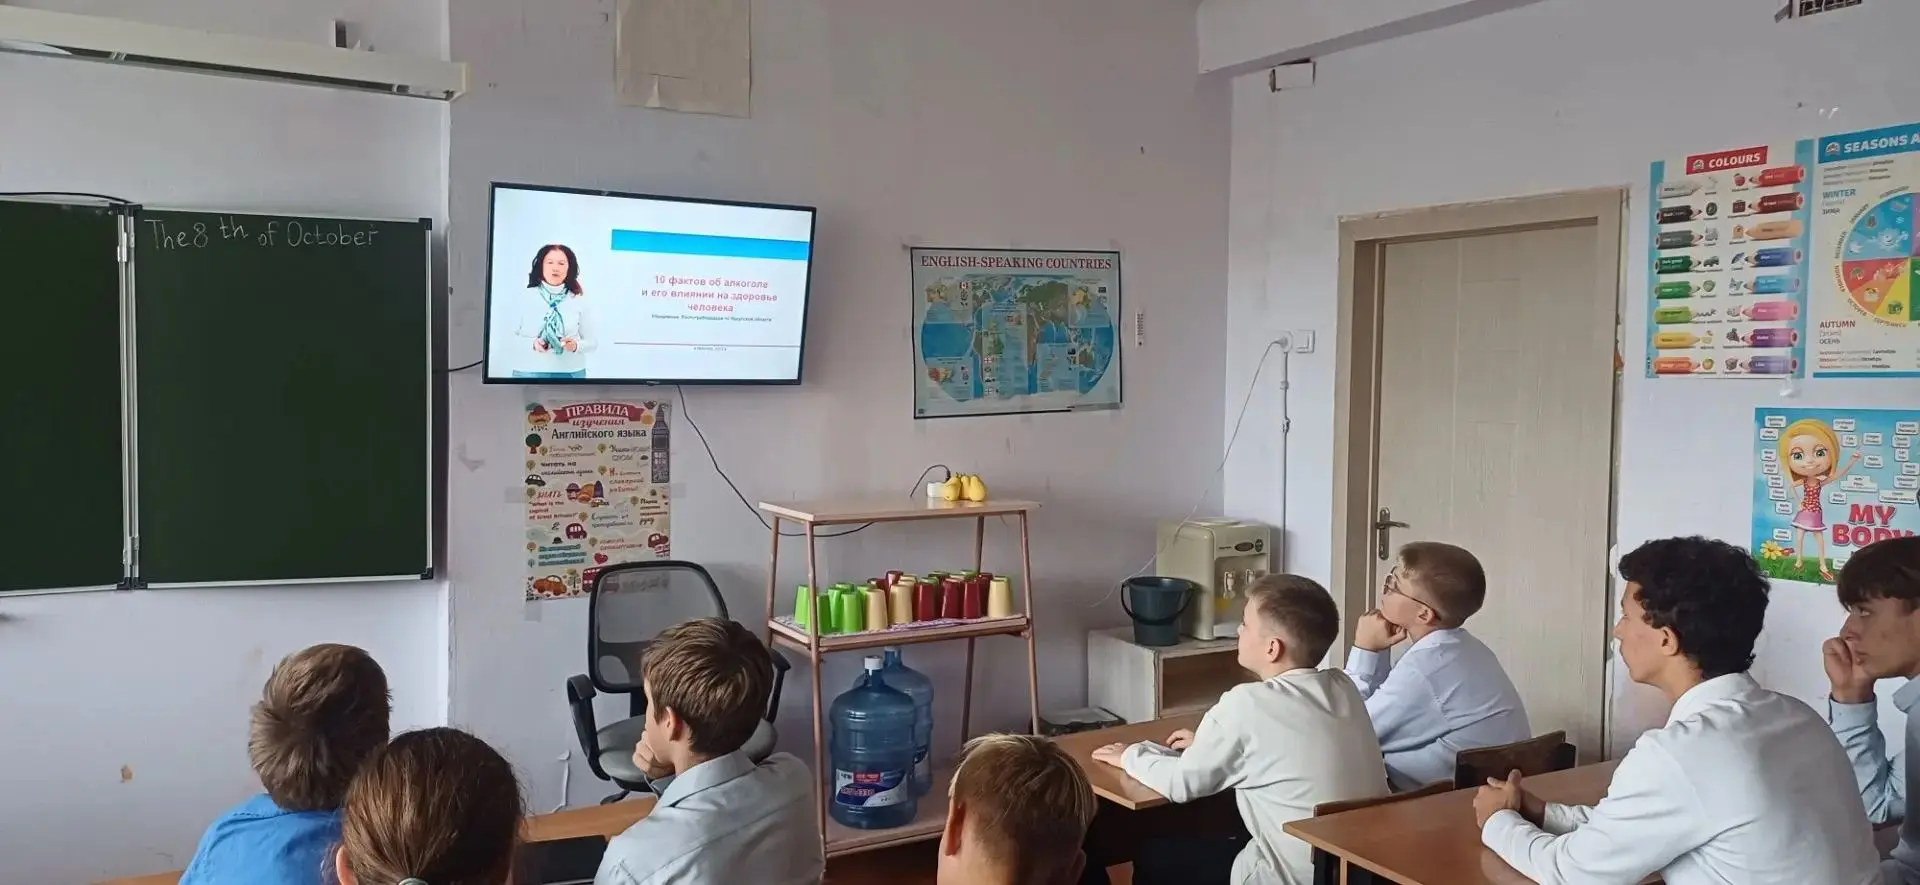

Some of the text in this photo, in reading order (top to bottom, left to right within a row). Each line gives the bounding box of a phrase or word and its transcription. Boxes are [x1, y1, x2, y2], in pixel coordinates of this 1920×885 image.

[1844, 135, 1908, 153] SEASONS
[1708, 152, 1761, 169] COLOURS
[1823, 188, 1856, 199] WINTER
[144, 215, 379, 250] The 8 th of October
[921, 255, 1112, 270] ENGLISH-SPEAKING COUNTRIES
[655, 275, 768, 290] 10 фактов об алкоголе
[641, 289, 648, 297] и
[651, 290, 668, 299] его
[670, 291, 714, 299] влиянии
[730, 293, 778, 303] здоровье
[687, 303, 734, 312] человека
[1819, 321, 1856, 329] AUTUMN
[565, 403, 629, 417] ПРАВИЛА
[572, 418, 626, 429] изучения
[551, 428, 647, 440] Английского языка
[1848, 503, 1897, 527] MY
